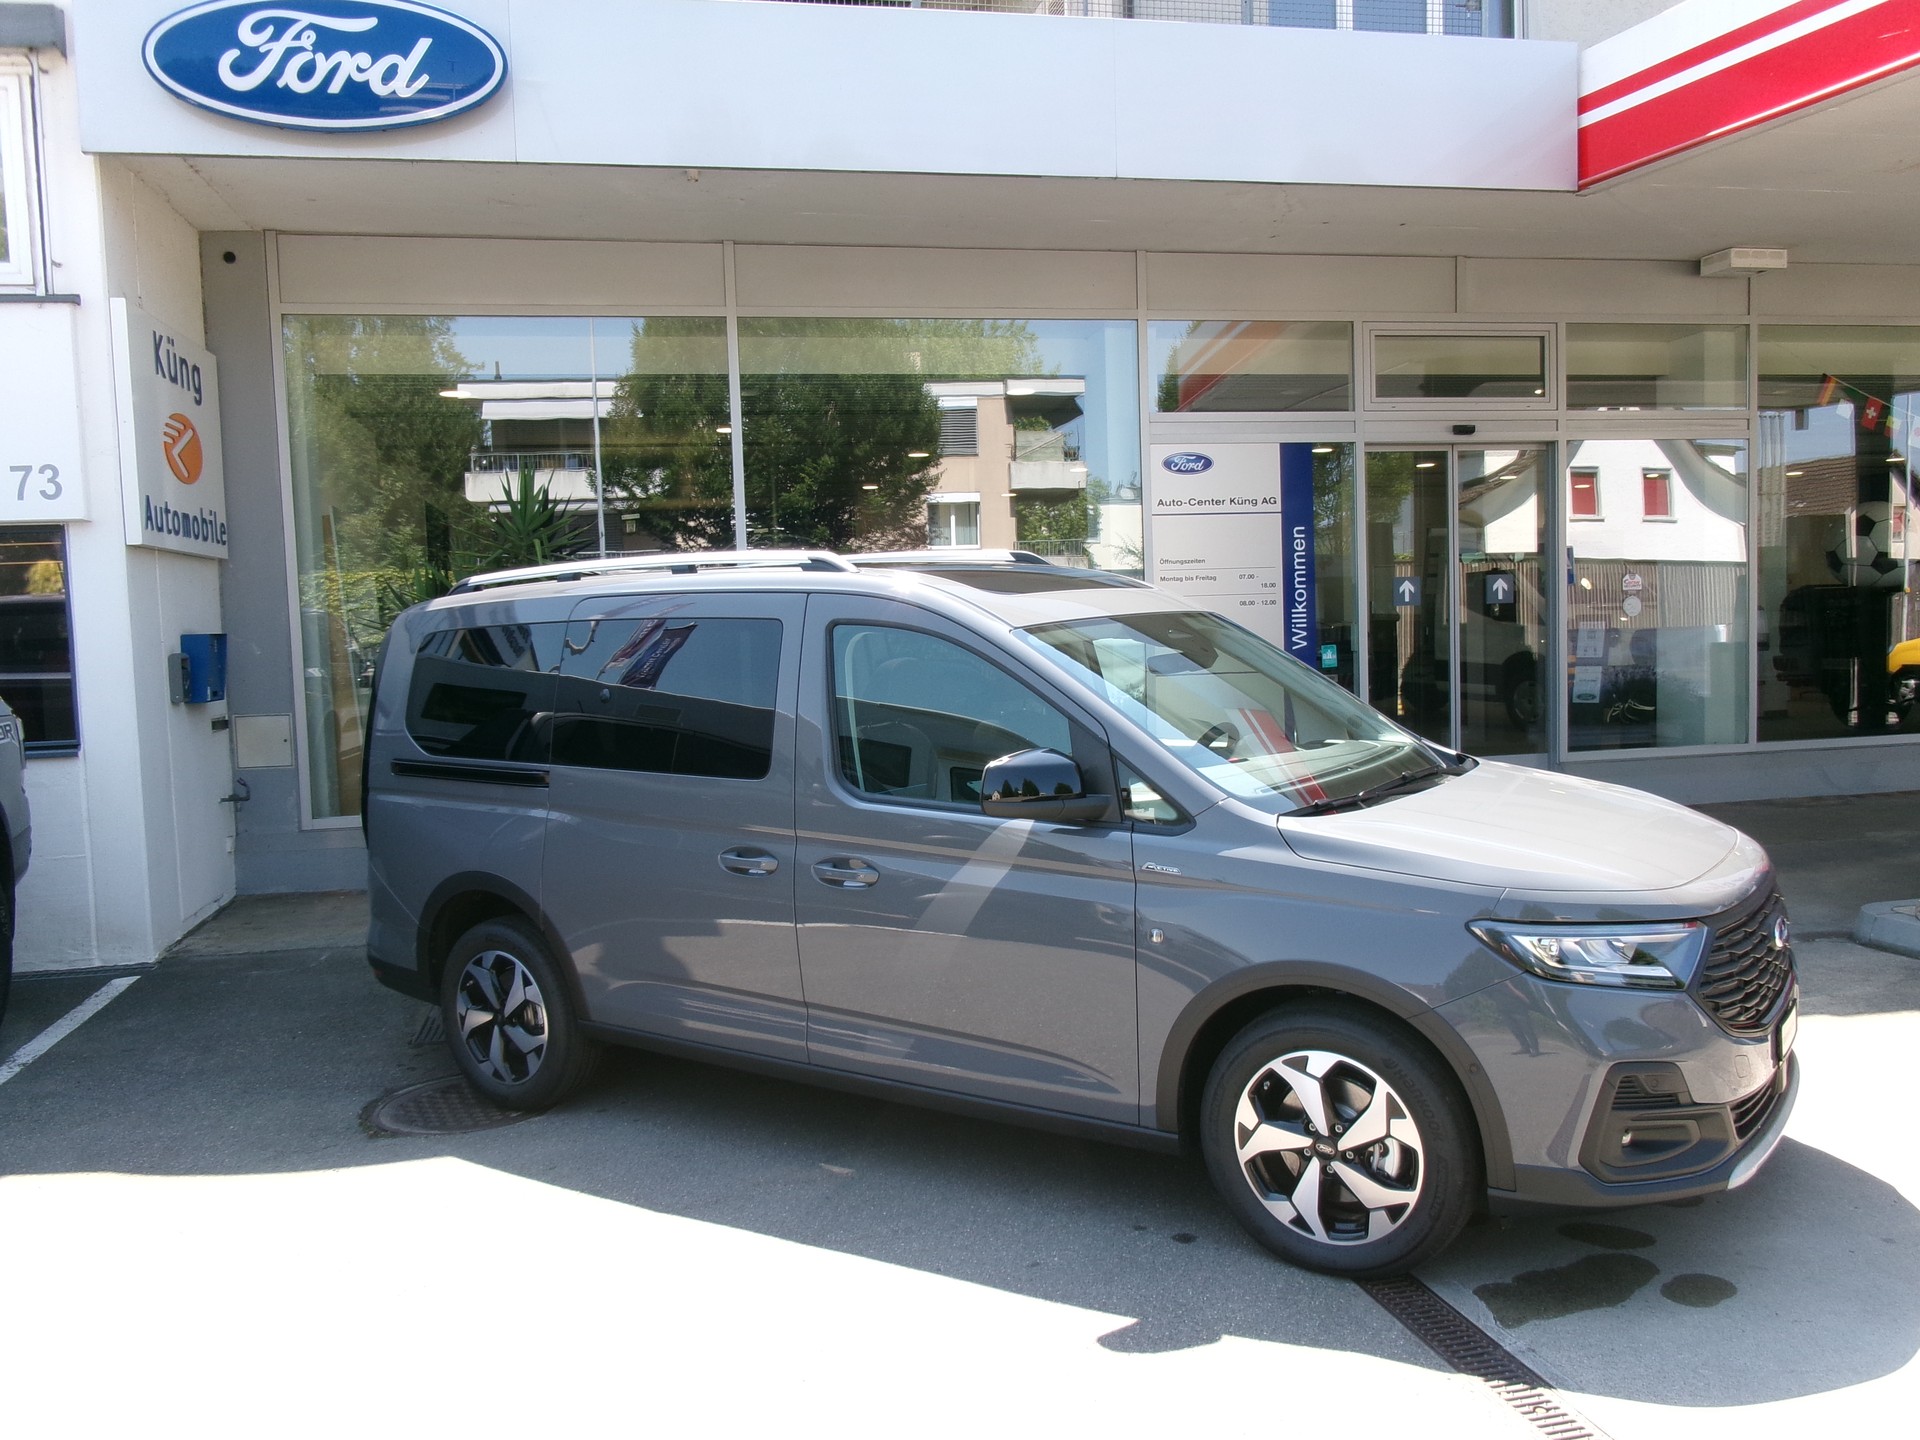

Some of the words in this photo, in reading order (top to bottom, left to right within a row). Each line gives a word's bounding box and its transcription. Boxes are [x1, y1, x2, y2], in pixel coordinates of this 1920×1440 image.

[217, 9, 433, 97] Ford
[152, 330, 203, 406] Küng
[1170, 455, 1205, 472] Ford
[9, 464, 63, 501] 73
[145, 495, 227, 546] Automobile
[1157, 498, 1226, 508] Auto-Center
[1229, 496, 1258, 508] Küng
[1261, 497, 1277, 506] AG
[1159, 557, 1206, 565] Öffnungszeiten
[1160, 575, 1183, 583] Montag
[1195, 574, 1217, 582] Freitag
[1291, 526, 1308, 650] Willkommen
